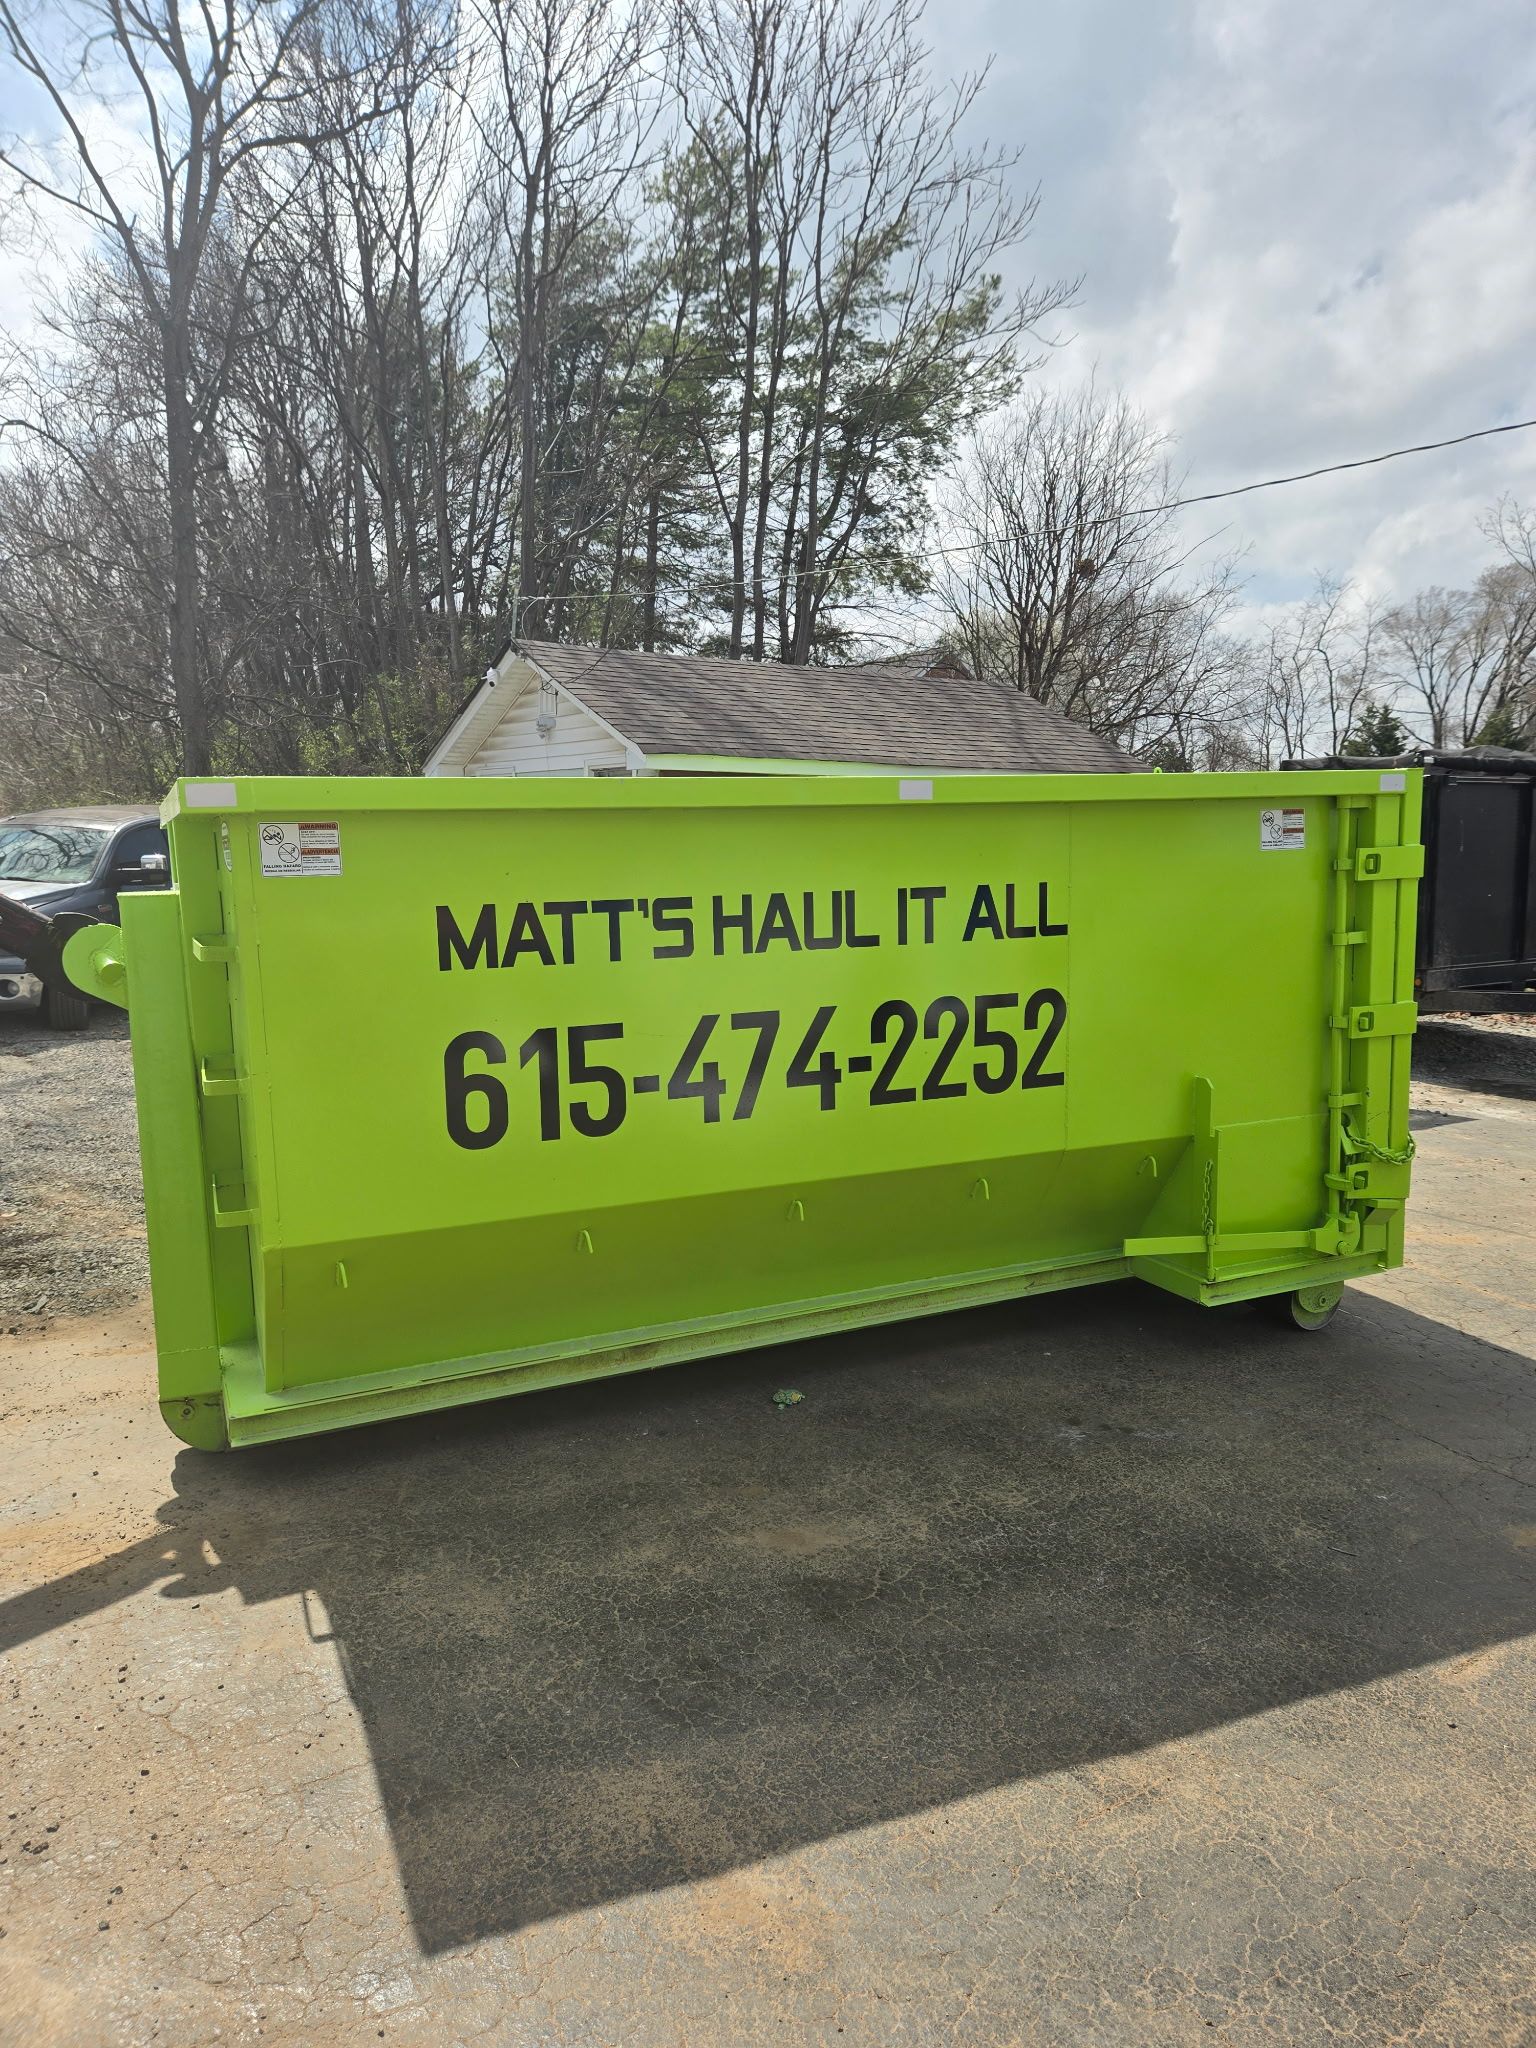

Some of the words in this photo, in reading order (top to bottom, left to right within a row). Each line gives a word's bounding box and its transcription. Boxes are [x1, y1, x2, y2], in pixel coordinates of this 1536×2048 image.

[435, 897, 695, 972] MATT'S
[712, 889, 881, 956] HAUL
[897, 886, 947, 946] IT
[962, 881, 1069, 942] ALL
[443, 988, 1067, 1151] 615-474-2252
